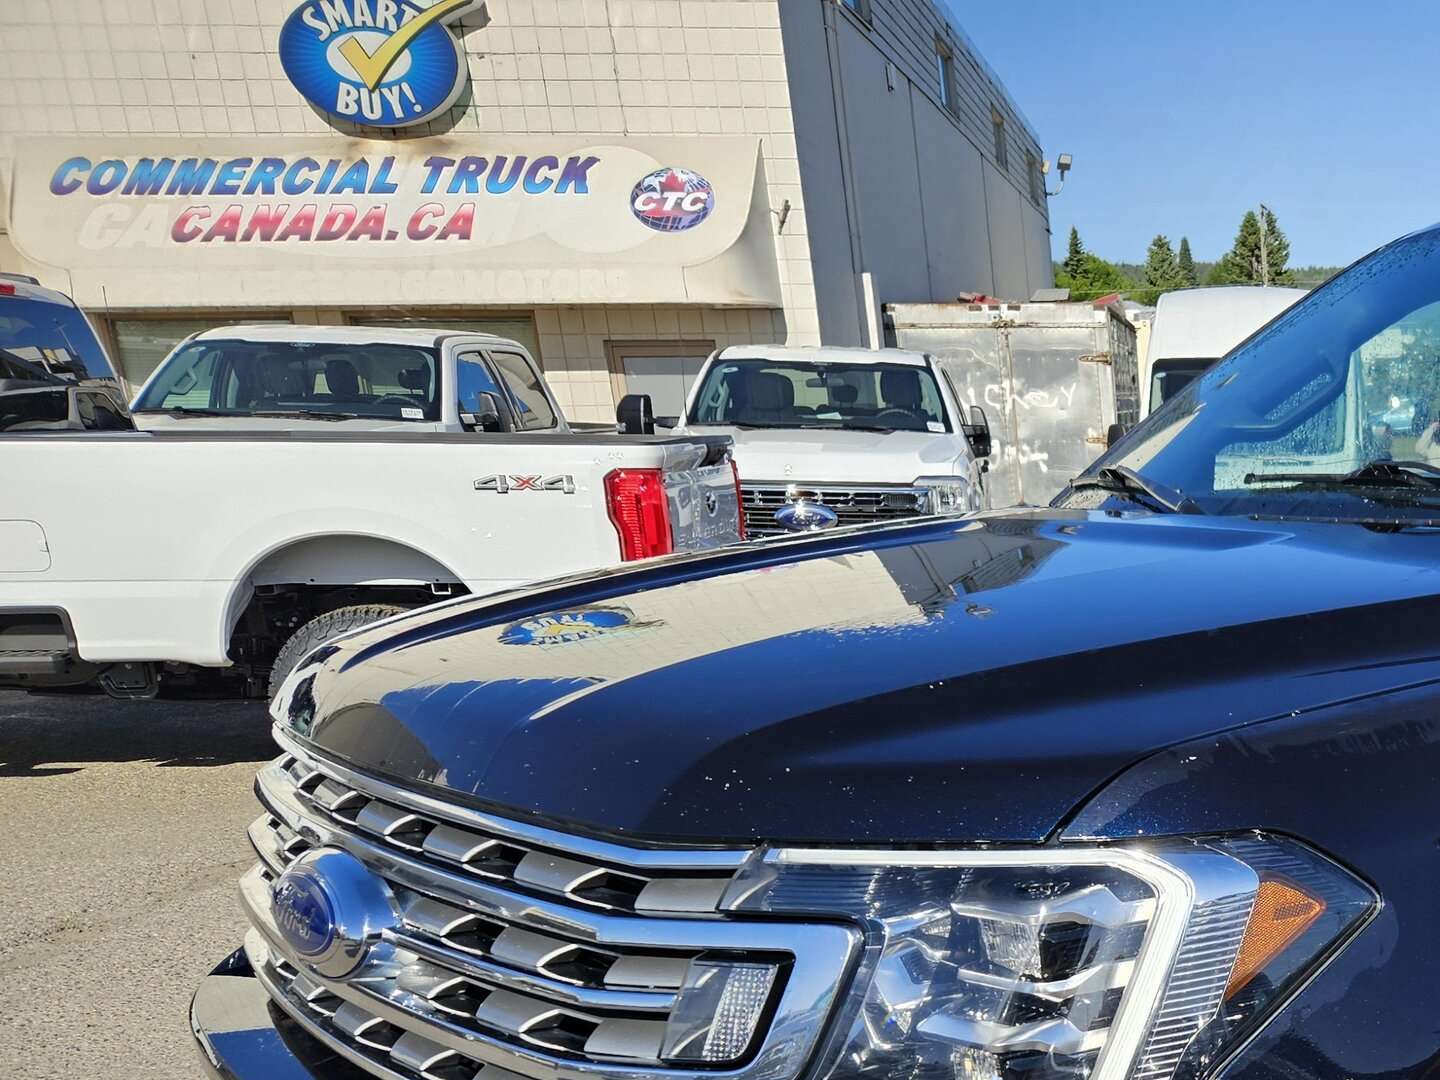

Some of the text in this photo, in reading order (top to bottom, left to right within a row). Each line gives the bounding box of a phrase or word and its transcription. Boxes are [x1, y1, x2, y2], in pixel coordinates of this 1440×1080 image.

[336, 82, 422, 120] BUY!
[49, 155, 601, 196] COMMERCIAL TRUCK
[634, 191, 708, 212] CTC
[170, 202, 476, 243] CANADA.CA
